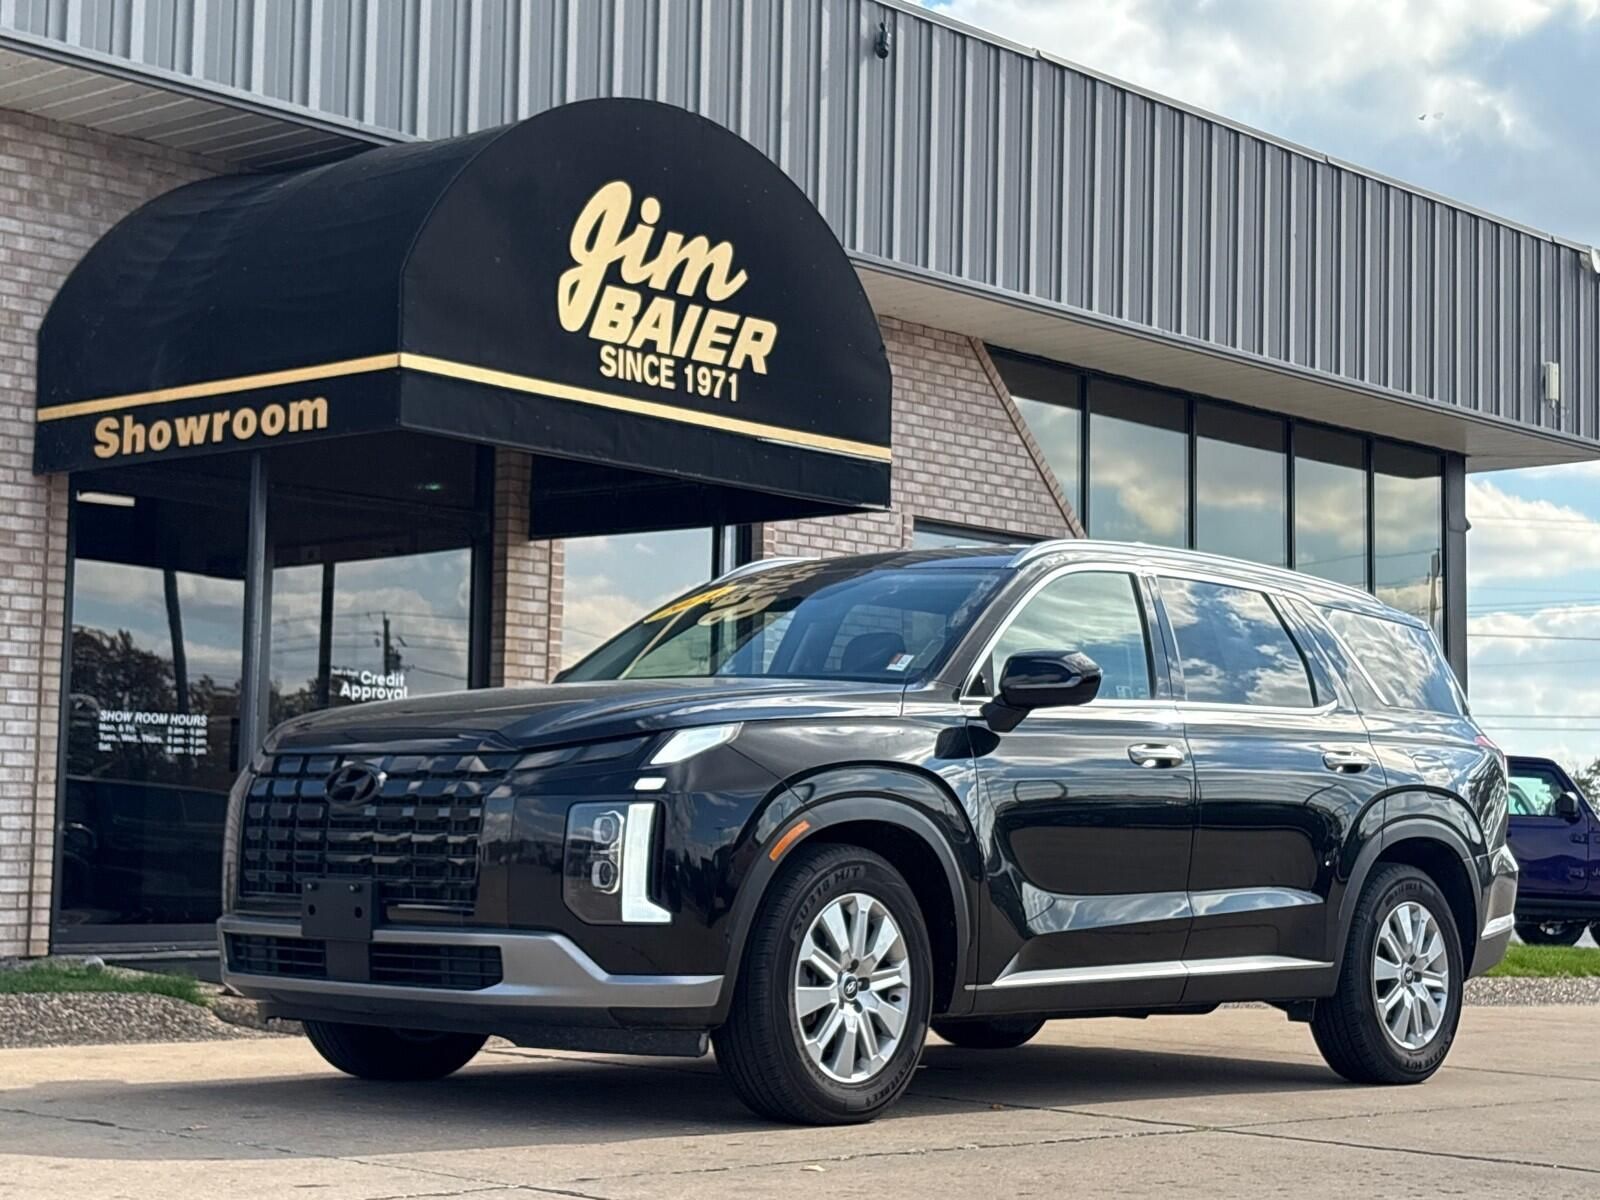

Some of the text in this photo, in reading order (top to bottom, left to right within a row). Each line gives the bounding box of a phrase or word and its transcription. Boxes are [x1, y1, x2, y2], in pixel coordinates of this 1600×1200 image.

[557, 180, 748, 332] Jim
[588, 285, 778, 375] BAIER
[600, 345, 738, 402] SINCE 1971
[94, 396, 328, 458] Showroom
[340, 680, 408, 701] Approval
[361, 669, 405, 687] Credit
[100, 709, 208, 727] SHOW ROOM HOURS
